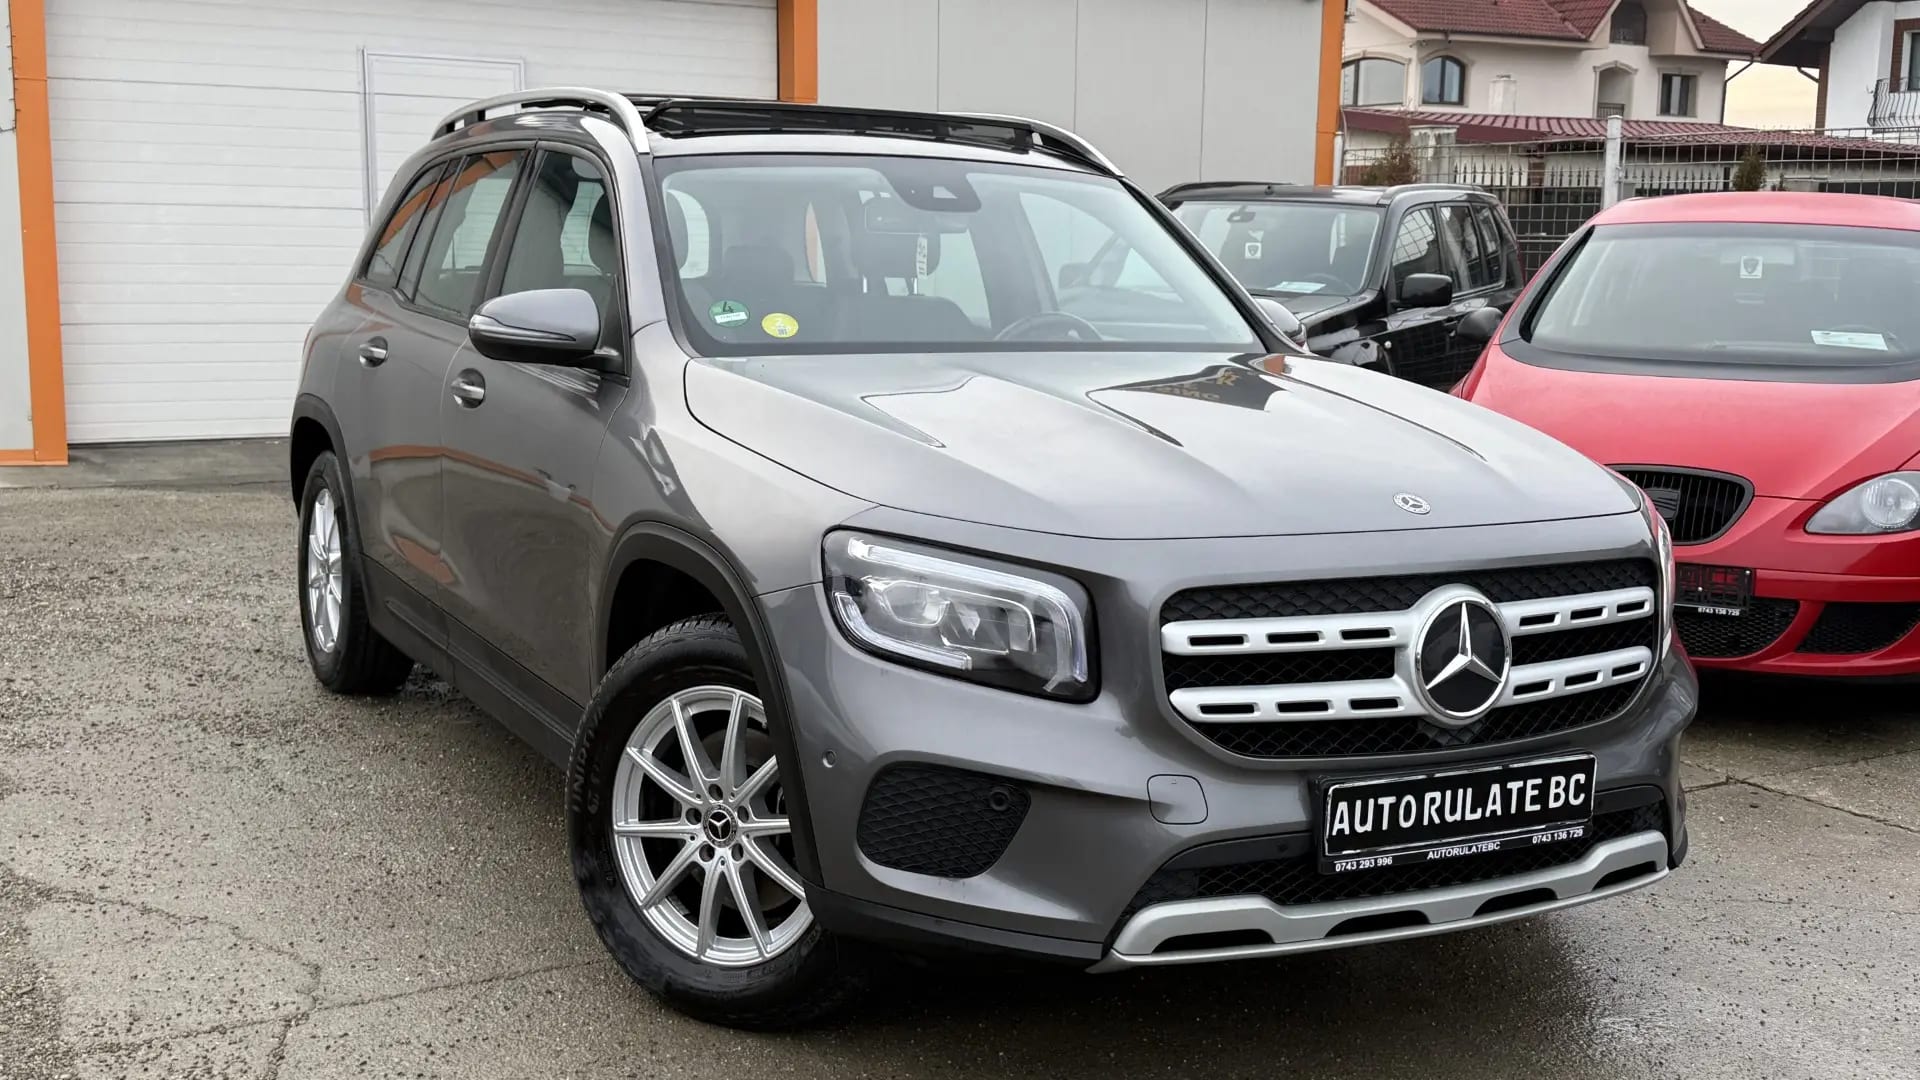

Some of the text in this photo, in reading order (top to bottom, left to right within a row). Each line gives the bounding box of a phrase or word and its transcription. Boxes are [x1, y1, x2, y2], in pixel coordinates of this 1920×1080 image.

[1332, 773, 1586, 836] AUTO RULATE BC
[1532, 828, 1584, 844] 0743 136 729
[1427, 842, 1501, 860] AUTORULATEBC
[1335, 856, 1393, 872] 0743 293 996
